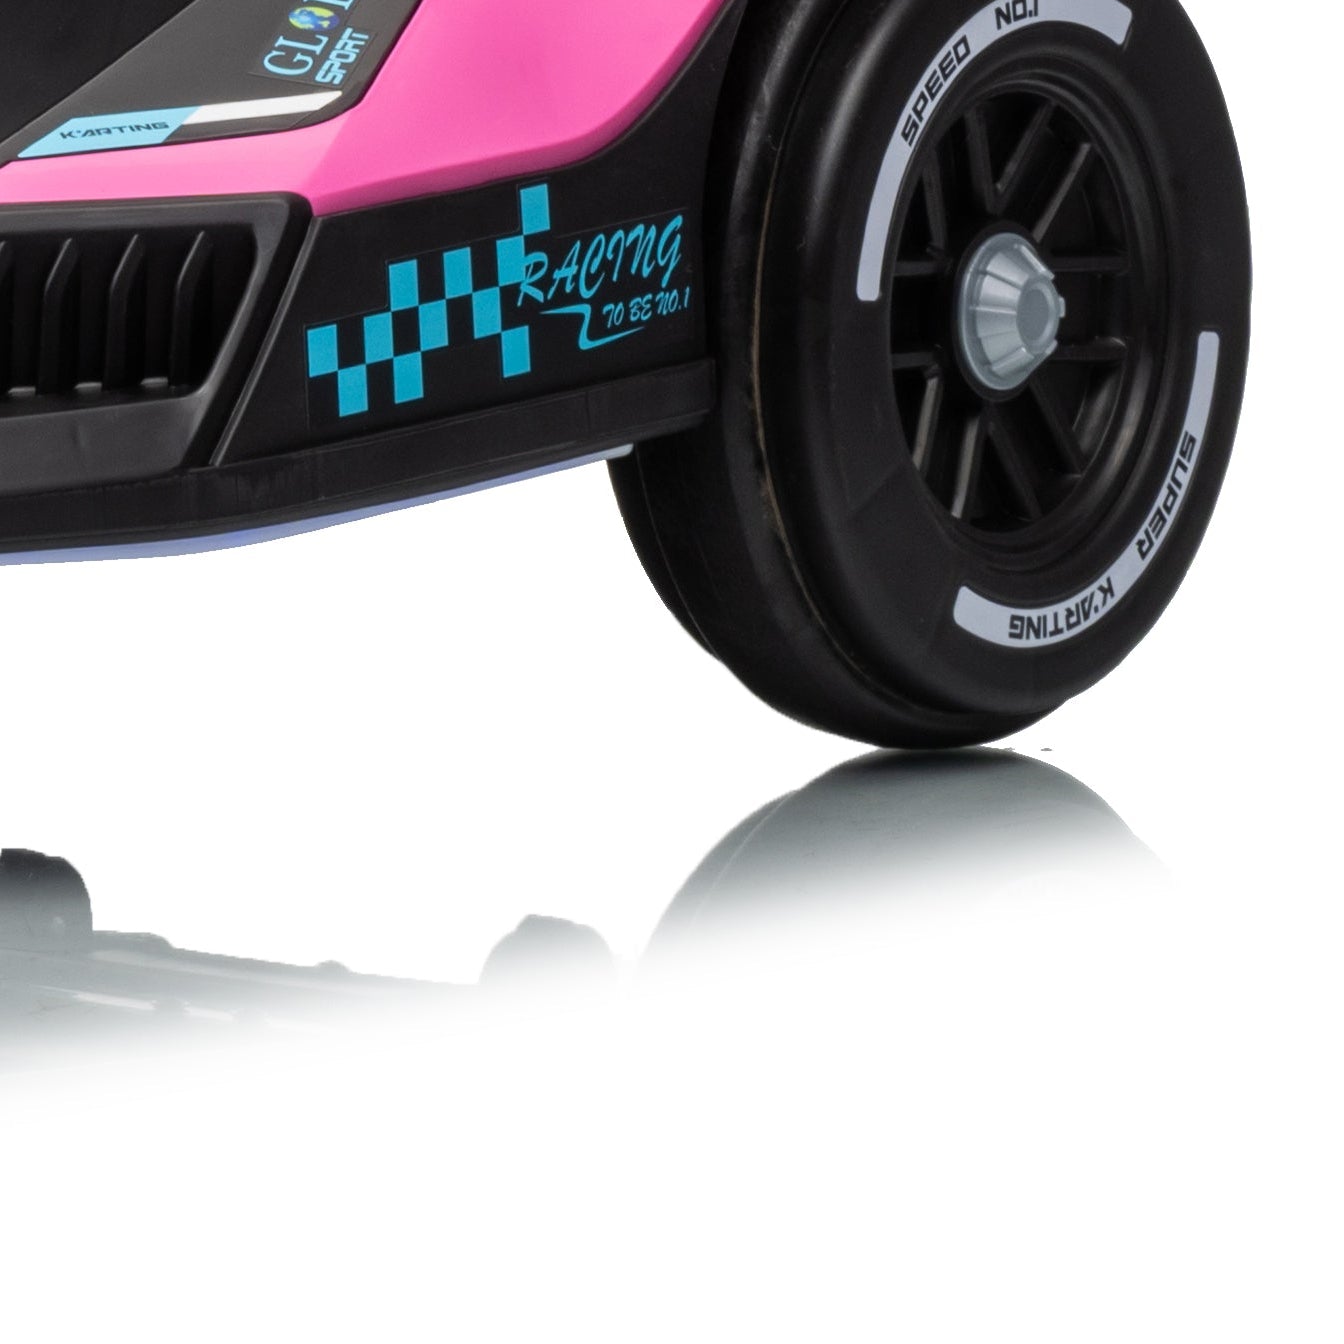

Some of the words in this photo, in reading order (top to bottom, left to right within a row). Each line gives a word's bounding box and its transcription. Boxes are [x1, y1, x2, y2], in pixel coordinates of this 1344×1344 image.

[314, 27, 371, 86] SPORT
[900, 34, 971, 147] SPEED
[60, 120, 170, 140] K'ARTING
[516, 214, 684, 308] RACING
[602, 304, 624, 329] TO
[629, 298, 653, 323] BE
[656, 286, 691, 316] NO.1
[1135, 431, 1197, 561] SUPER
[1008, 576, 1115, 640] K'ARTING
